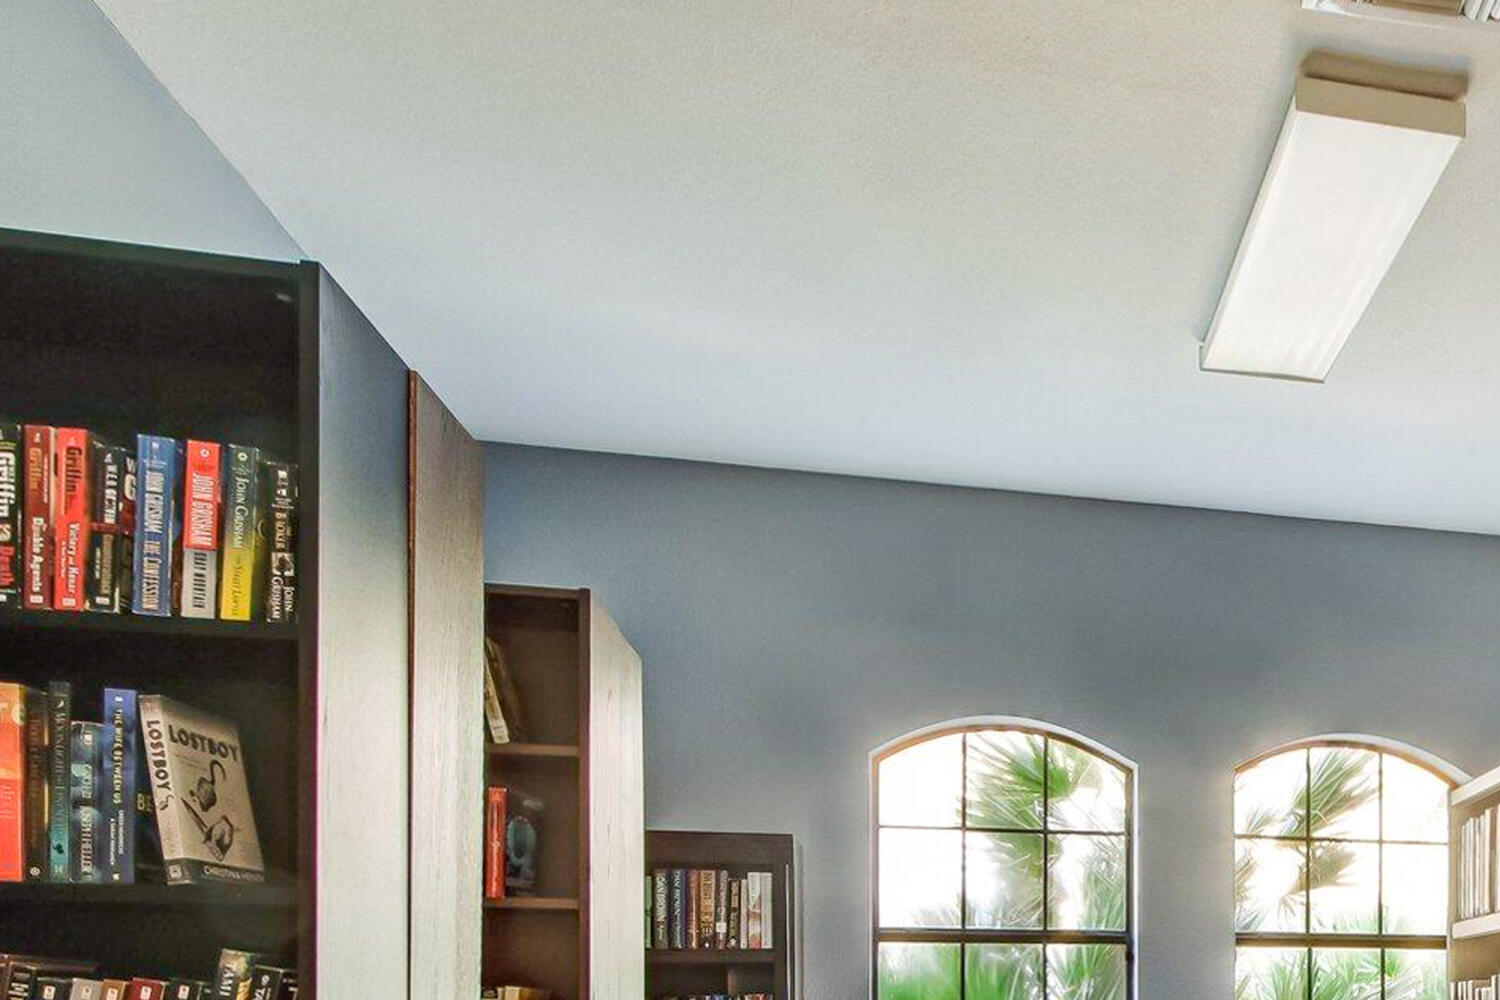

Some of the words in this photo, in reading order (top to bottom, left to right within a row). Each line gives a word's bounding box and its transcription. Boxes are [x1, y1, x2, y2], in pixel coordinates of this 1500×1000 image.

[65, 446, 82, 494] Griffin
[145, 471, 163, 492] JOHN
[192, 472, 214, 500] JOHN
[234, 475, 249, 504] JOHN
[144, 495, 163, 533] GRISHAM
[190, 502, 212, 546] GRISHAM
[232, 506, 249, 549] GRISHAM
[32, 517, 44, 553] Double
[67, 523, 80, 557] Victory
[145, 540, 160, 556] THE
[31, 555, 43, 592] Agents
[142, 557, 162, 613] CONFESSION
[271, 576, 285, 619] GRISHAM
[283, 586, 294, 612] JOHN
[113, 709, 122, 724] THE
[113, 727, 122, 747] WIFE
[113, 750, 122, 790] BETWEEN
[113, 793, 121, 804] US
[219, 962, 237, 997] TAMI
